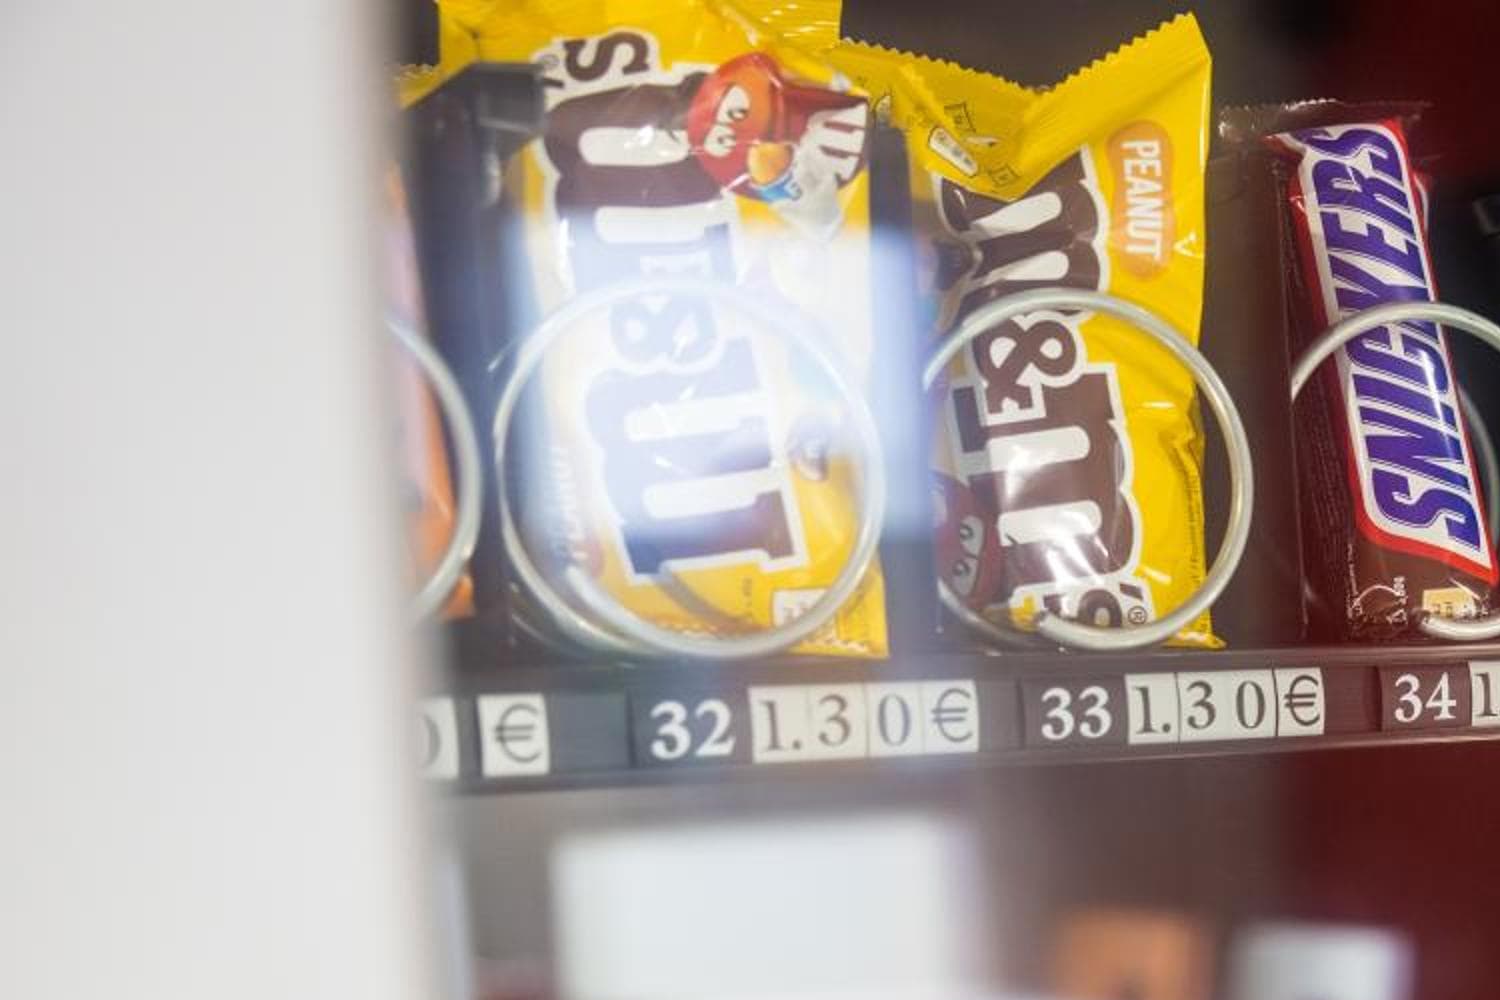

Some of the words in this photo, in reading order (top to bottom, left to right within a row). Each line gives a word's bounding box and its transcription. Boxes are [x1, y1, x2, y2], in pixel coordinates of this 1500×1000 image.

[1120, 138, 1170, 262] PEANUT
[1299, 127, 1482, 551] SNICKERS
[1041, 685, 1112, 740] 33
[1394, 671, 1457, 723] 34
[650, 700, 736, 760] 32
